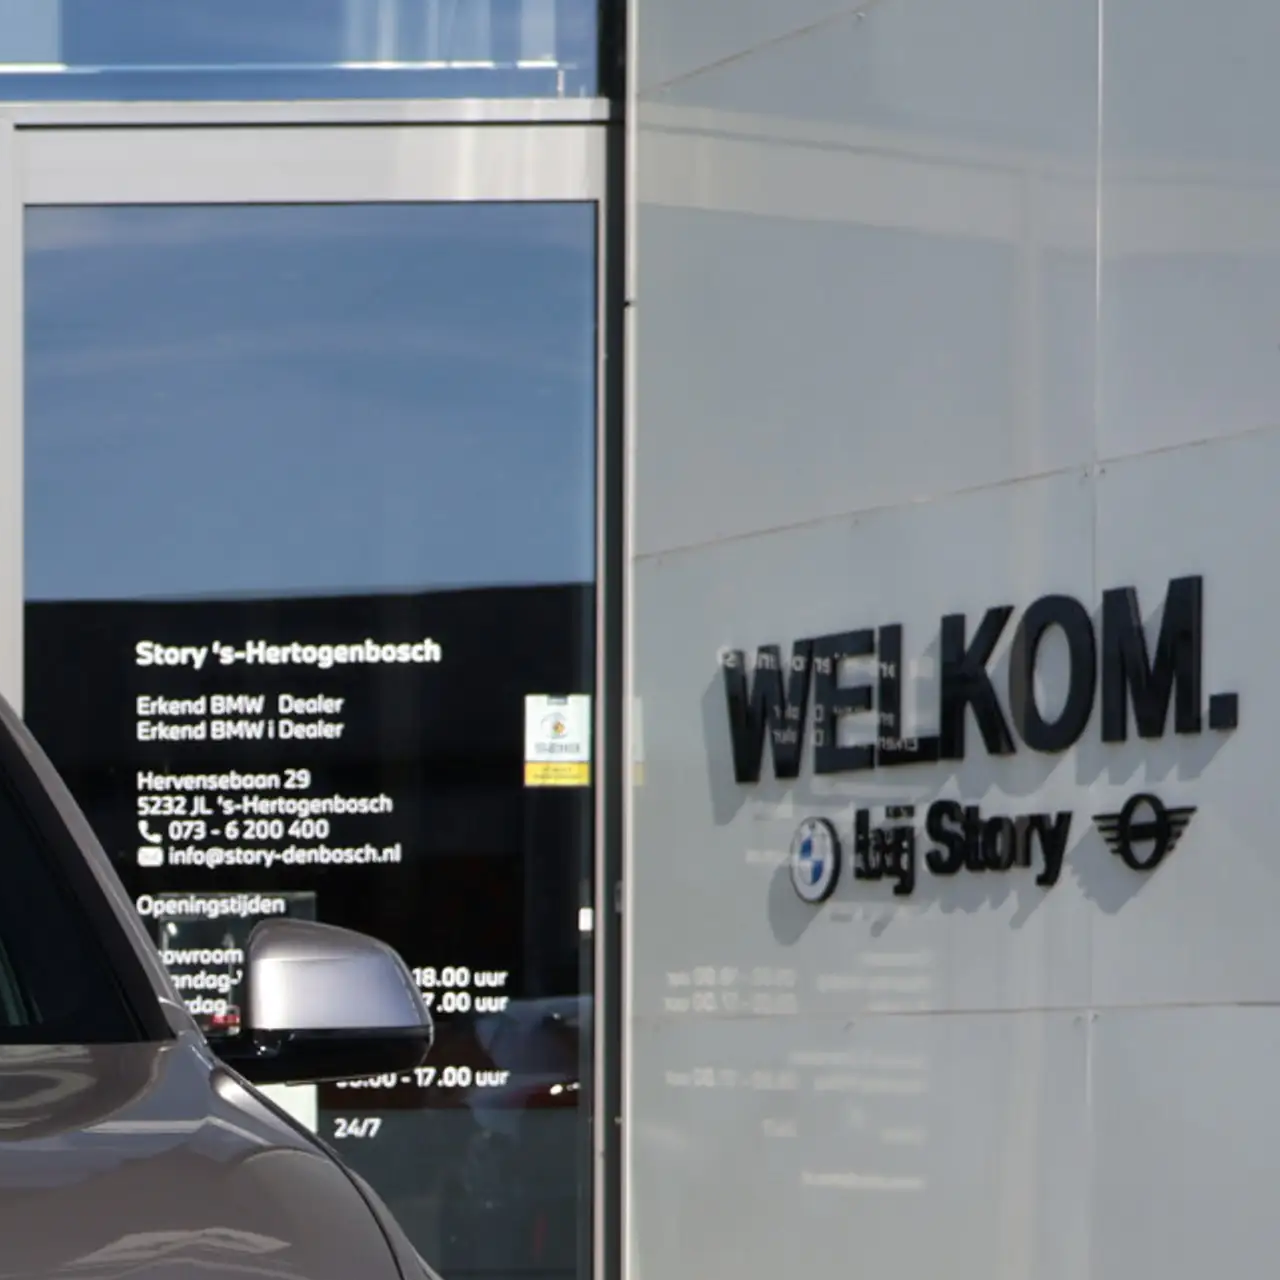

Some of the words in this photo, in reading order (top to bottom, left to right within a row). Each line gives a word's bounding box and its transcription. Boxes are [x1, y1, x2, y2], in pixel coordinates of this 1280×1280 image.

[136, 641, 207, 669] Story
[213, 638, 441, 669] 's-Hertogenbosch
[723, 574, 1238, 783] WELKOM.
[137, 696, 206, 715] Erkend
[211, 695, 264, 714] BMW
[279, 694, 344, 715] Dealer
[137, 721, 206, 740] Erkend
[211, 721, 264, 740] BMW
[268, 720, 274, 739] i
[279, 719, 344, 740] Dealer
[138, 770, 279, 791] Hervensebaan
[284, 769, 310, 789] 29
[138, 797, 186, 816] 5232
[190, 797, 213, 816] JL
[218, 794, 393, 818] 's-Hertogenbosch
[169, 821, 207, 841] 073
[225, 820, 238, 840] 6
[242, 820, 284, 840] 200
[288, 820, 330, 840] 400
[169, 844, 401, 868] info@story-denbosch.nl
[854, 804, 915, 895] bij
[926, 800, 1072, 887] Story
[137, 894, 285, 918] Openingstijden
[160, 949, 244, 965] owroom
[412, 967, 471, 987] 18.00
[474, 971, 508, 987] uur
[422, 992, 471, 1012] 7.00
[475, 996, 509, 1012] uur
[414, 1066, 471, 1087] 17.00
[476, 1070, 509, 1086] uur
[334, 1117, 381, 1138] 24/7
